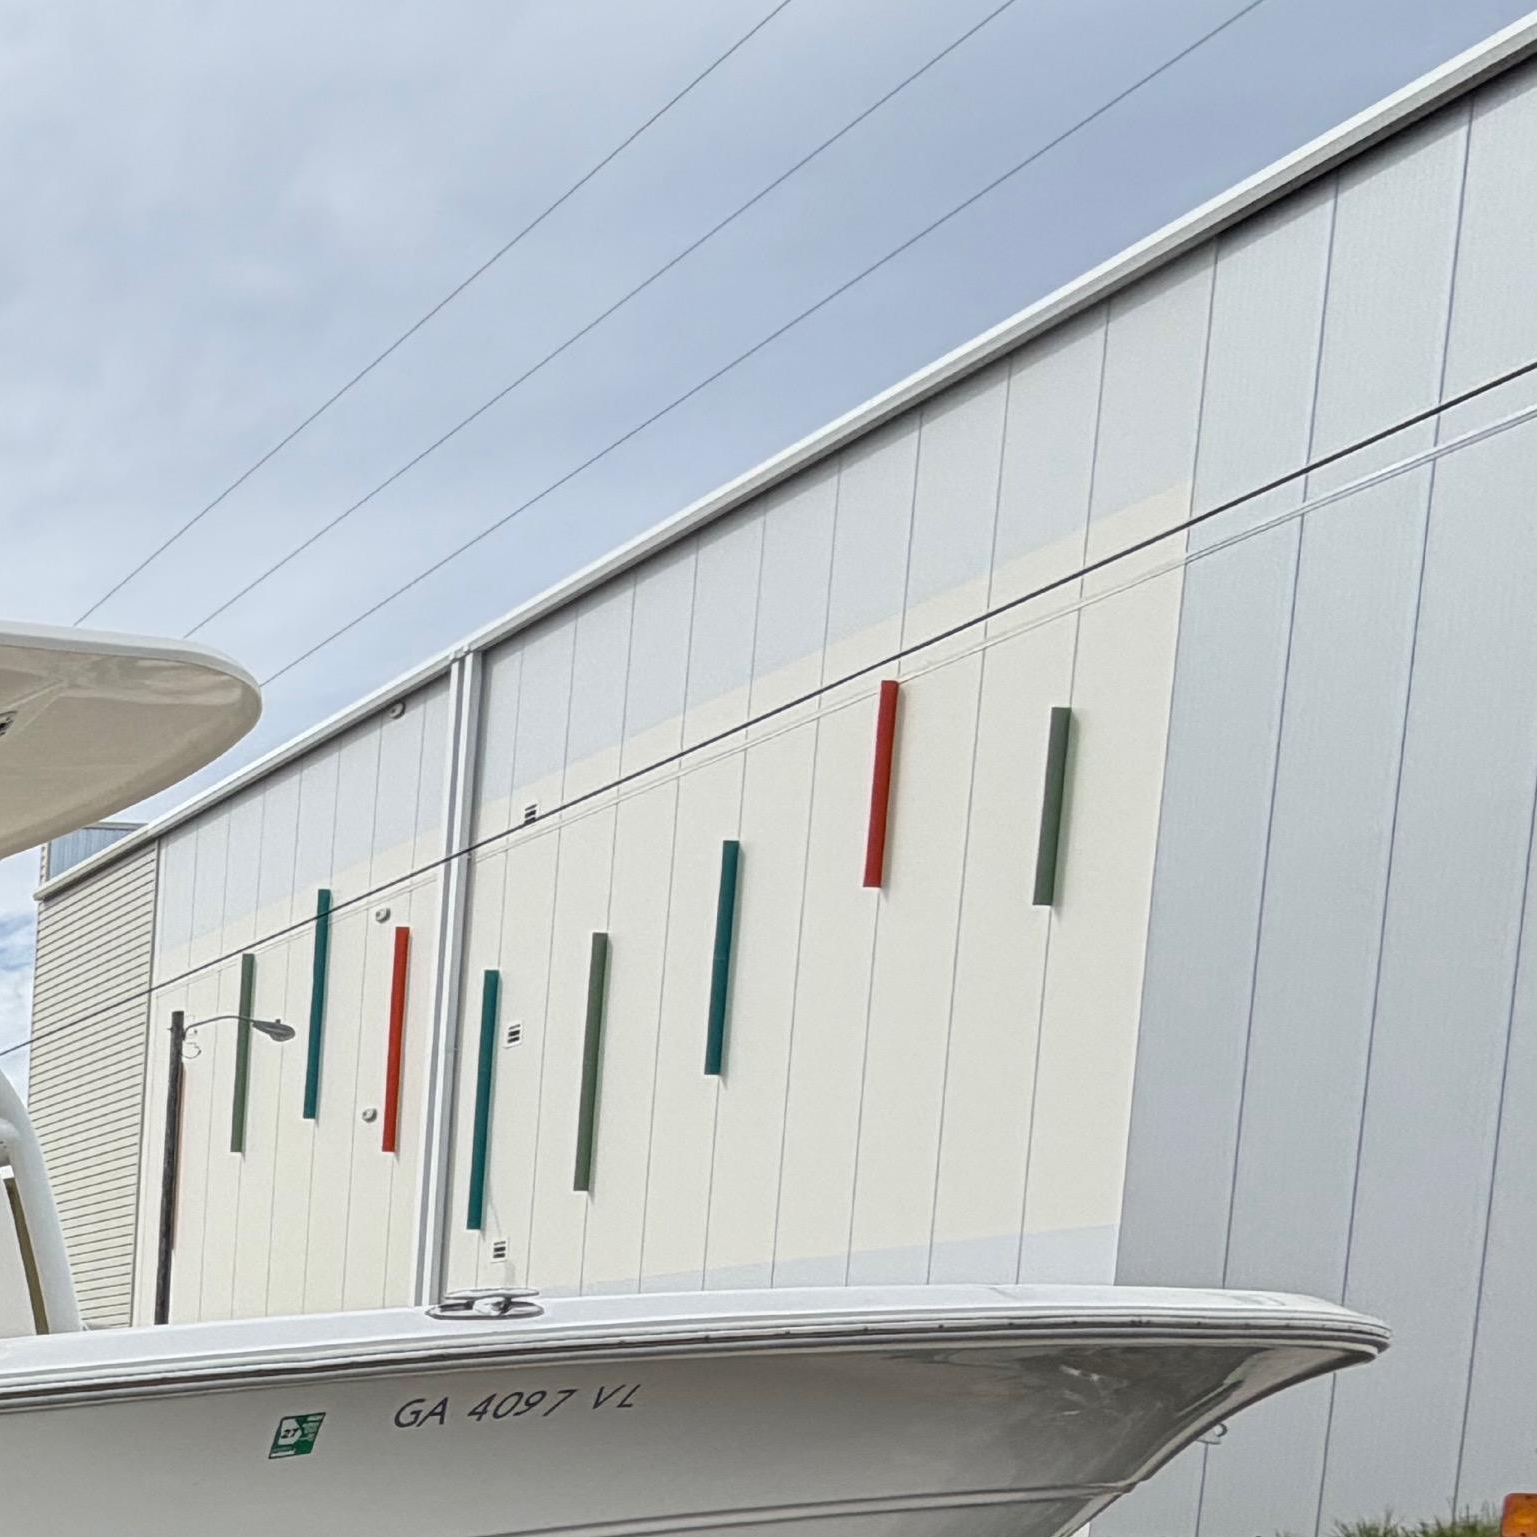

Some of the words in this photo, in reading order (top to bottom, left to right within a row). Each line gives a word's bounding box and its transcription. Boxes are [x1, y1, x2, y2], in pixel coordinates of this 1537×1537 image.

[394, 1396, 449, 1428] GA
[467, 1388, 578, 1422] 4097
[592, 1384, 641, 1410] VL
